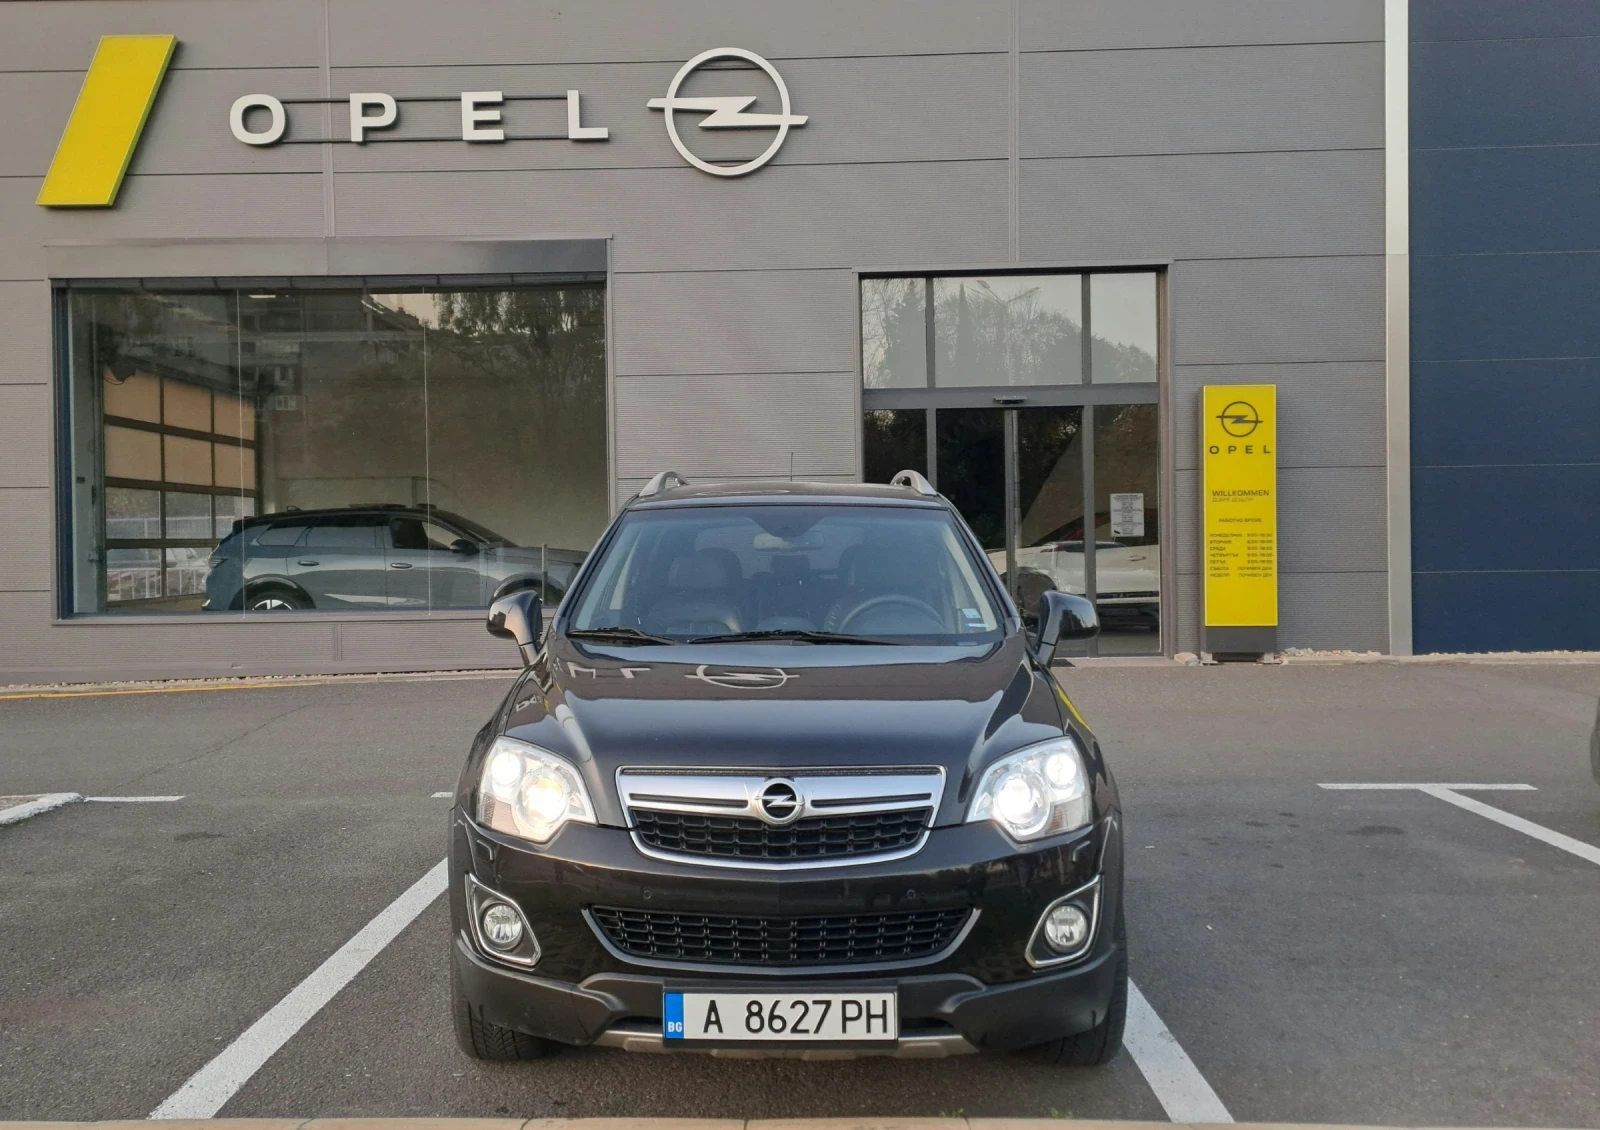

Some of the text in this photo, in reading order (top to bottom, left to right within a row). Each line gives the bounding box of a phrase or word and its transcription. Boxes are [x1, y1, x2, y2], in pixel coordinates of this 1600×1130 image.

[229, 89, 609, 146] OPEL
[1209, 445, 1271, 454] OPEL
[667, 1000, 888, 1034] BG A 8627 PH
